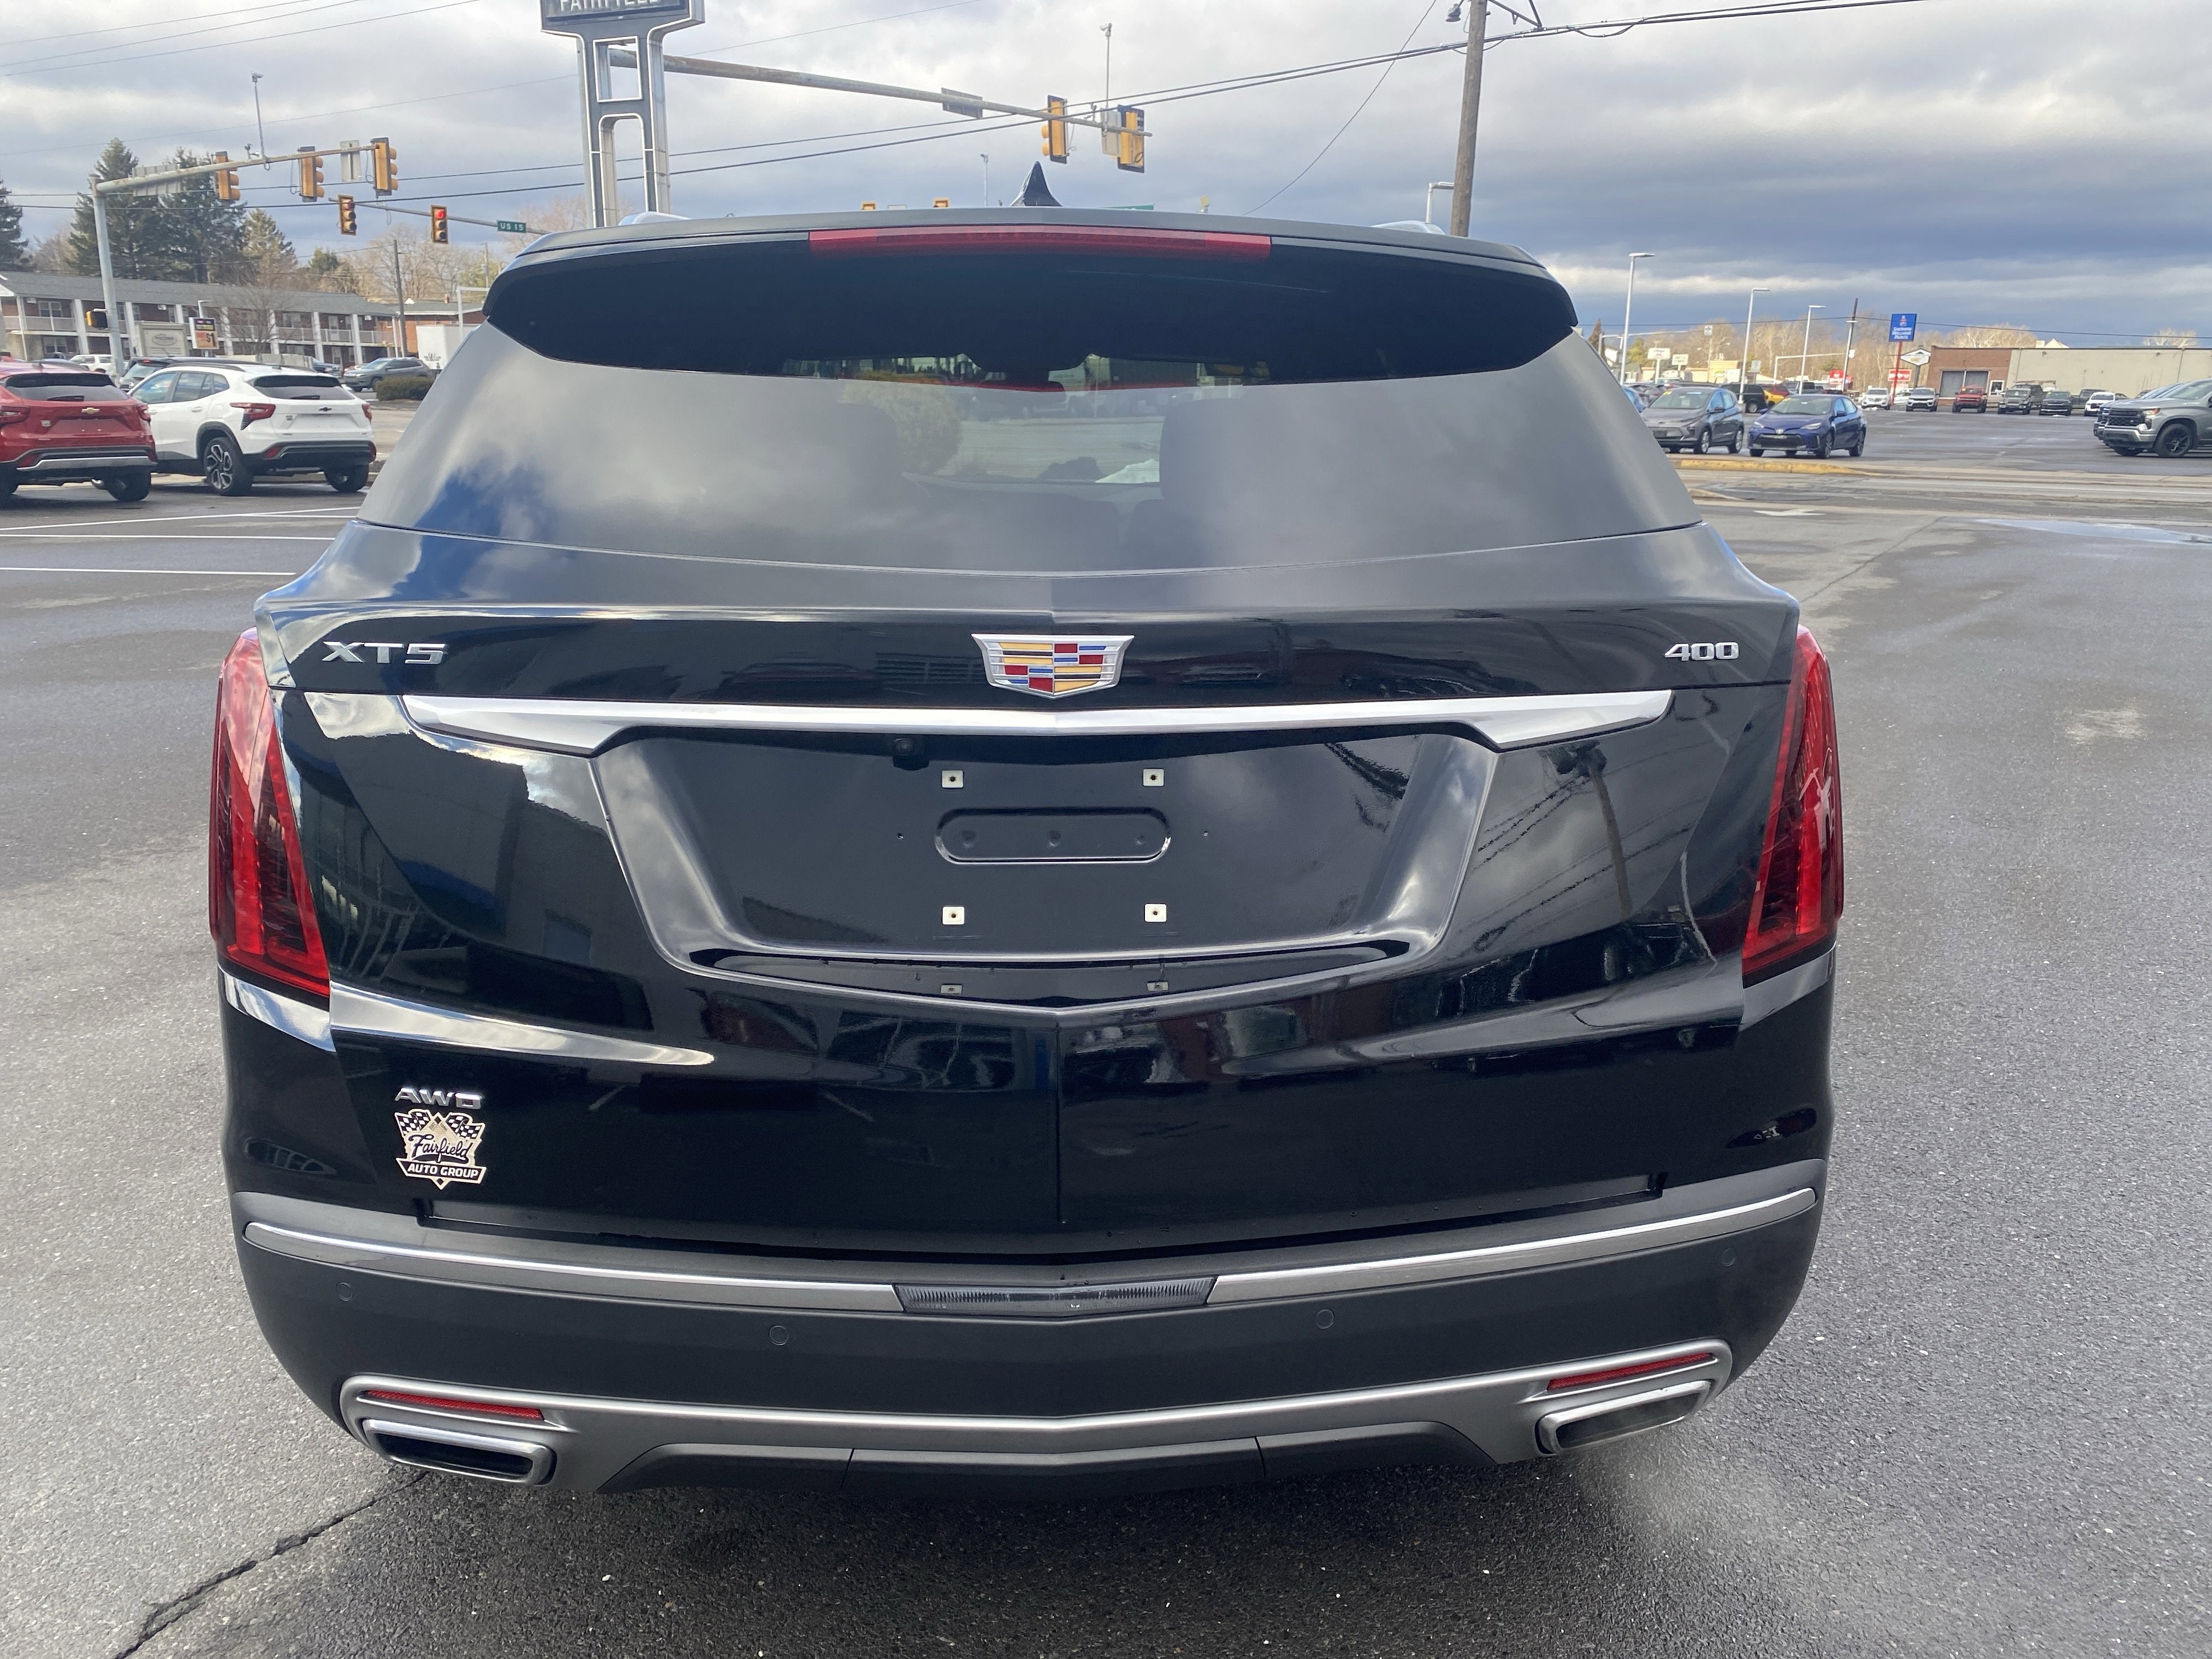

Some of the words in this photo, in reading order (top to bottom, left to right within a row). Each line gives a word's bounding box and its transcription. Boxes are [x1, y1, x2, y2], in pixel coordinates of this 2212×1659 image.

[321, 641, 447, 664] XT5
[1664, 642, 1739, 662] 400
[394, 1087, 482, 1110] AWD
[408, 1133, 473, 1161] Fairfield
[408, 1163, 438, 1175] AUTO
[440, 1166, 479, 1178] GROUP
